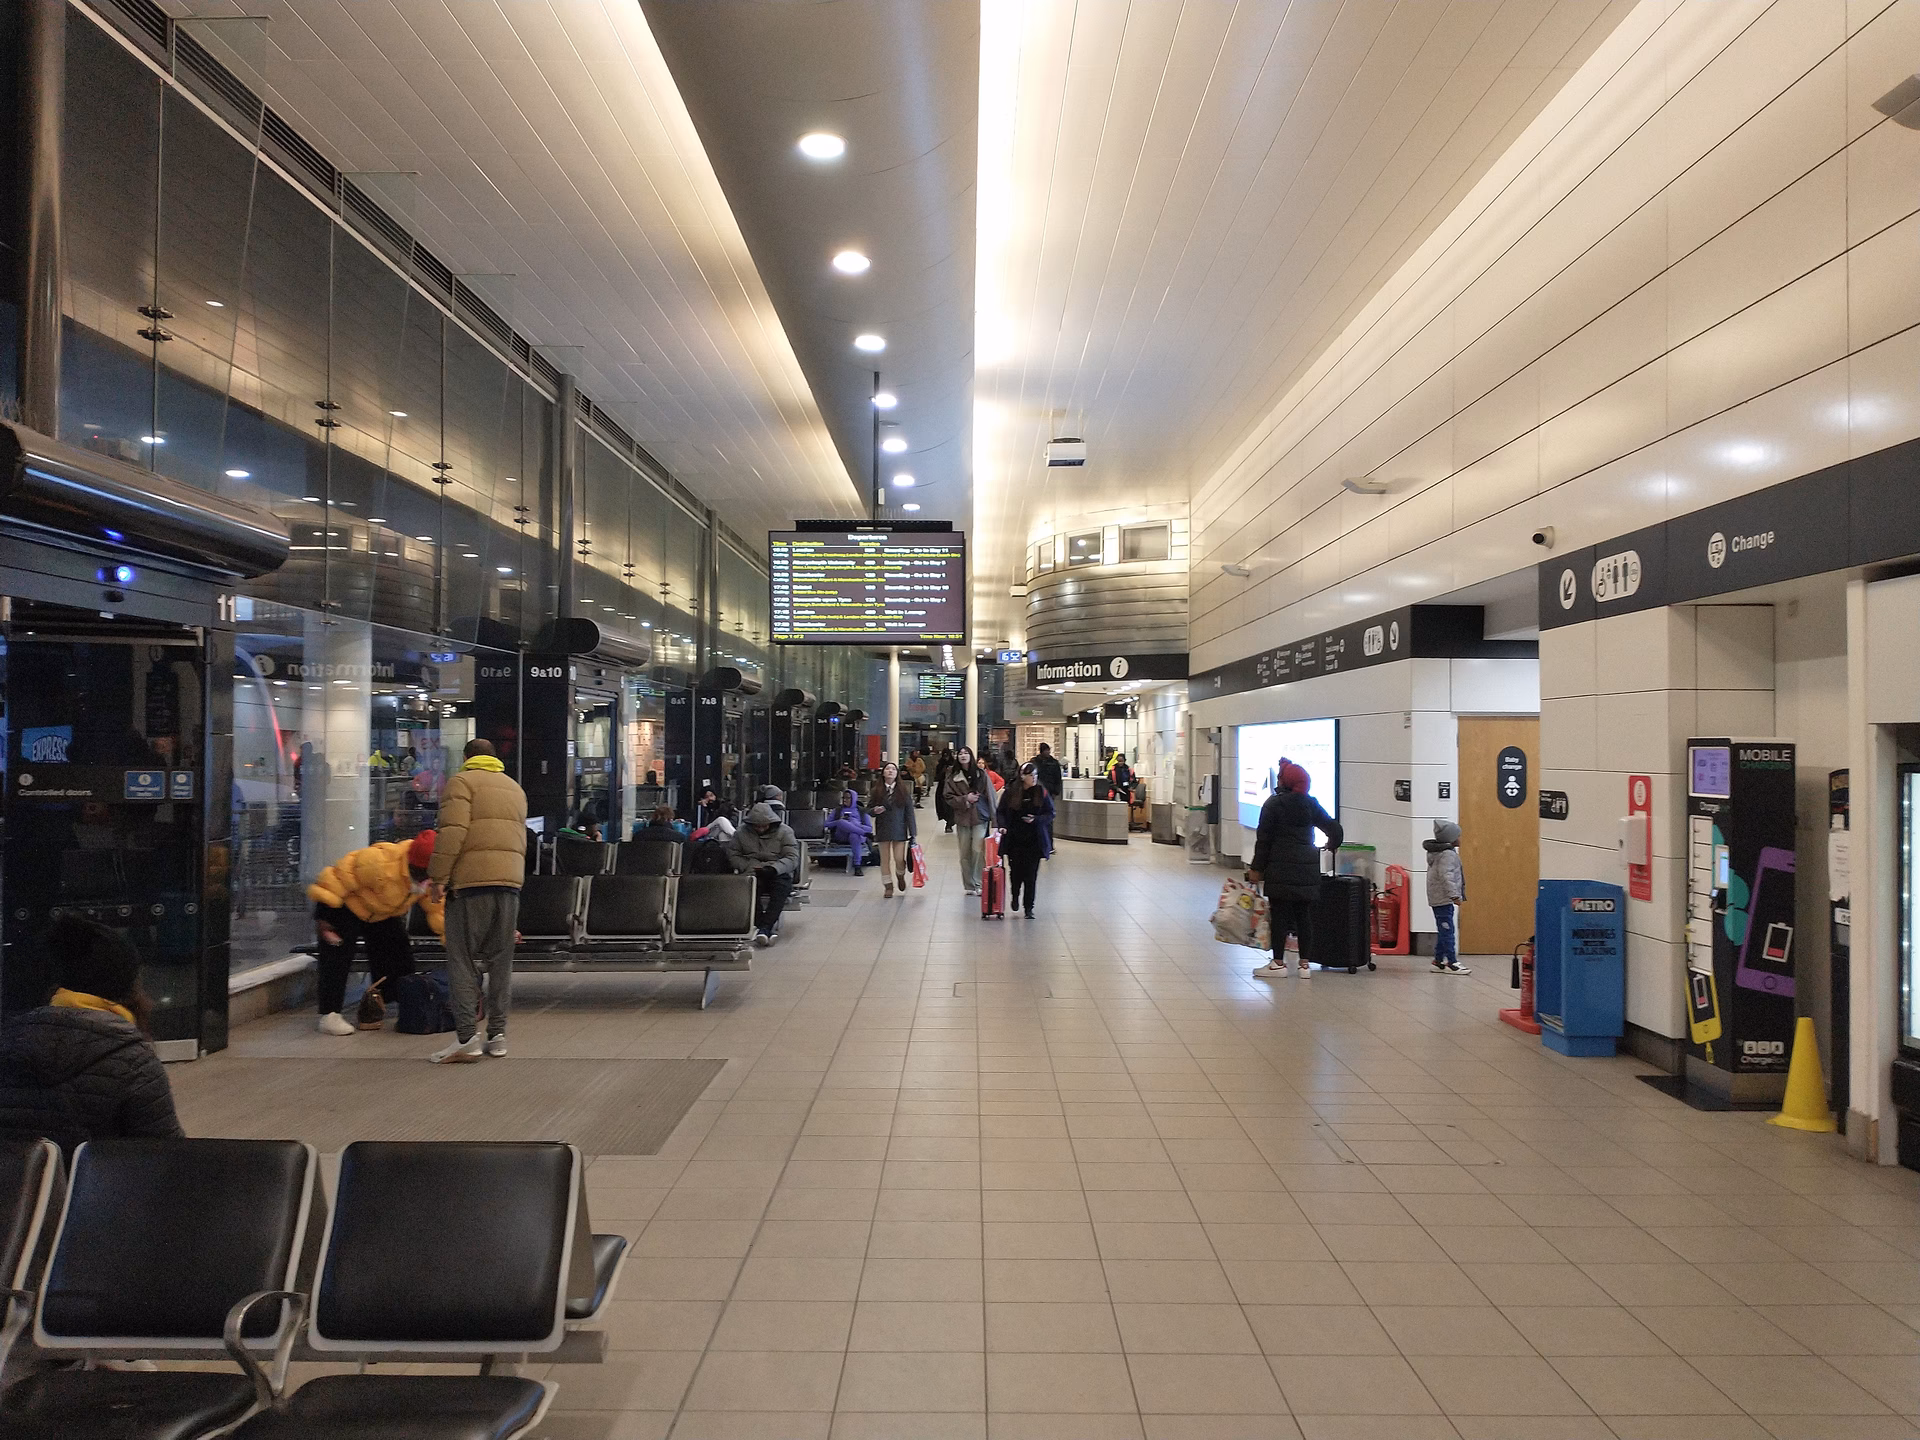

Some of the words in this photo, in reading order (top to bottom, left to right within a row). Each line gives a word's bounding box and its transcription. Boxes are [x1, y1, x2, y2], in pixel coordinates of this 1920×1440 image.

[1732, 531, 1775, 553] Change
[217, 594, 236, 623] 11
[530, 666, 562, 678] 9&10
[1036, 662, 1101, 680] Information
[1740, 749, 1791, 761] MOBILE
[1574, 900, 1614, 911] METRO
